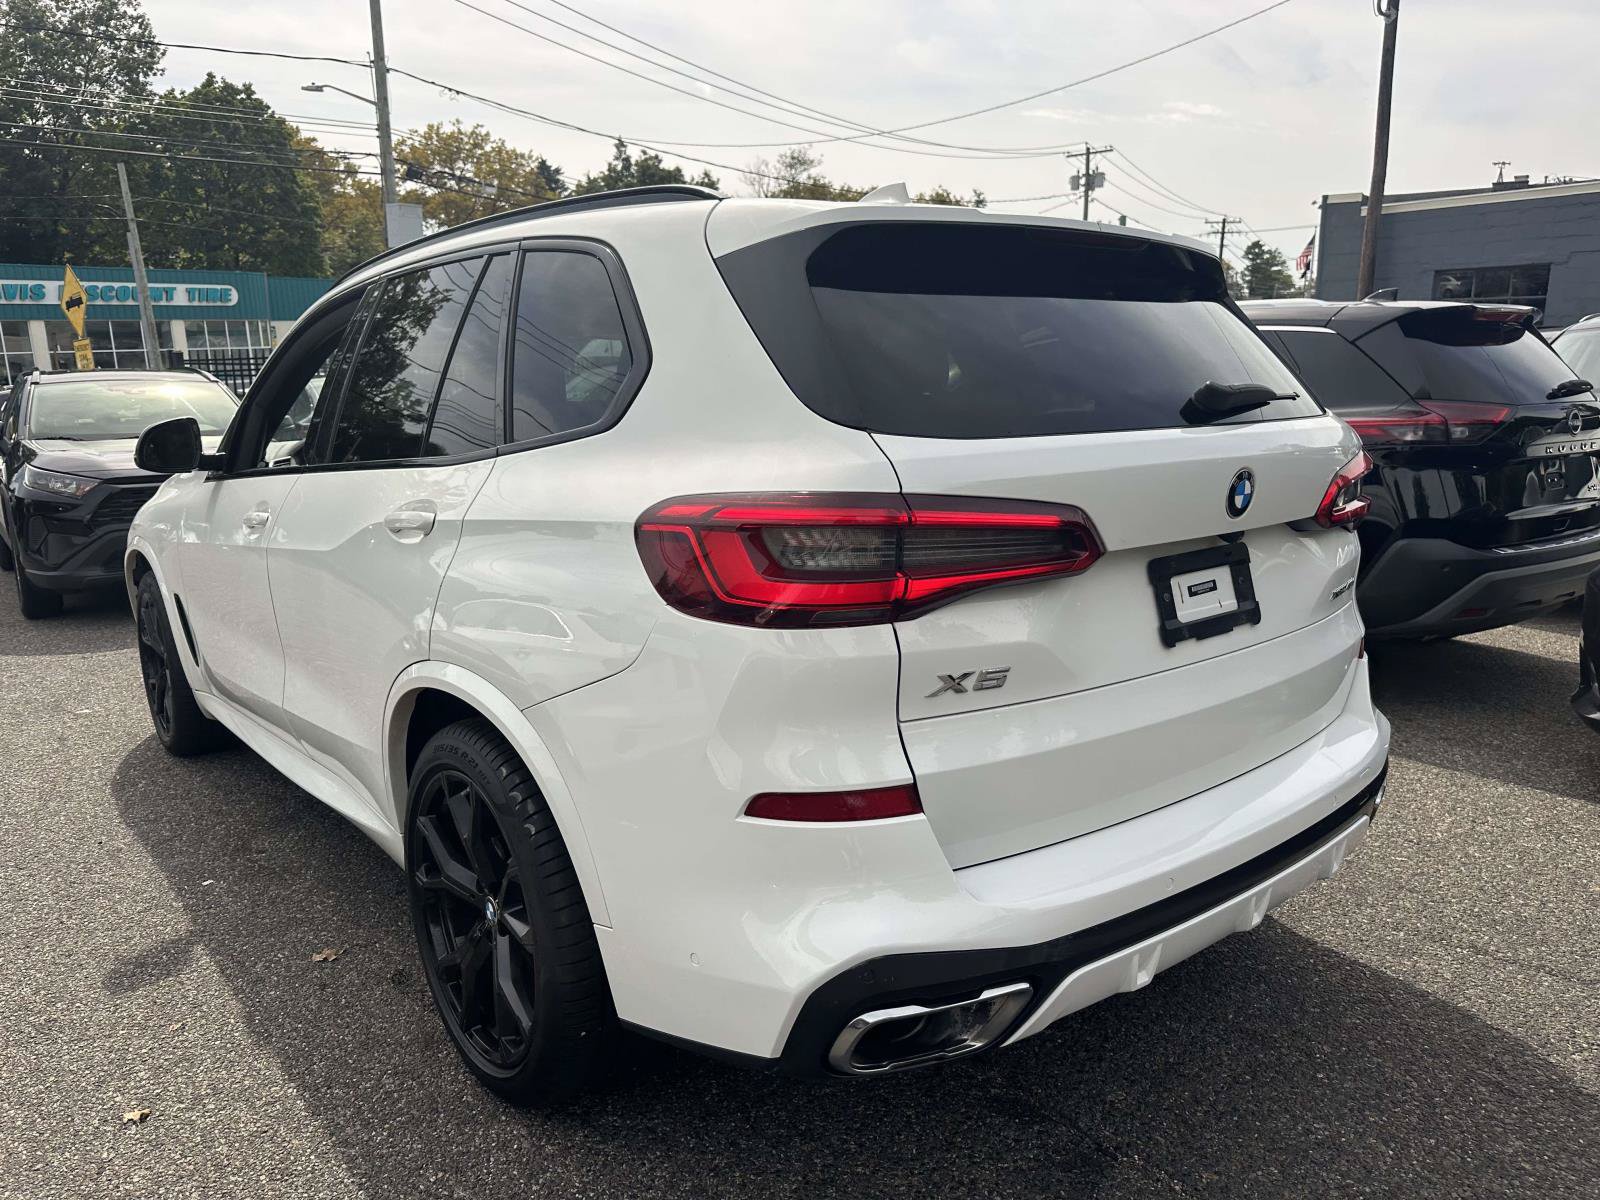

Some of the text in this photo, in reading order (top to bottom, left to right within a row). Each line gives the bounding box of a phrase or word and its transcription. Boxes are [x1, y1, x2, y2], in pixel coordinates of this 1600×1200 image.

[0, 283, 46, 301] VIS
[186, 287, 232, 304] TIRE
[924, 666, 1011, 698] X5
